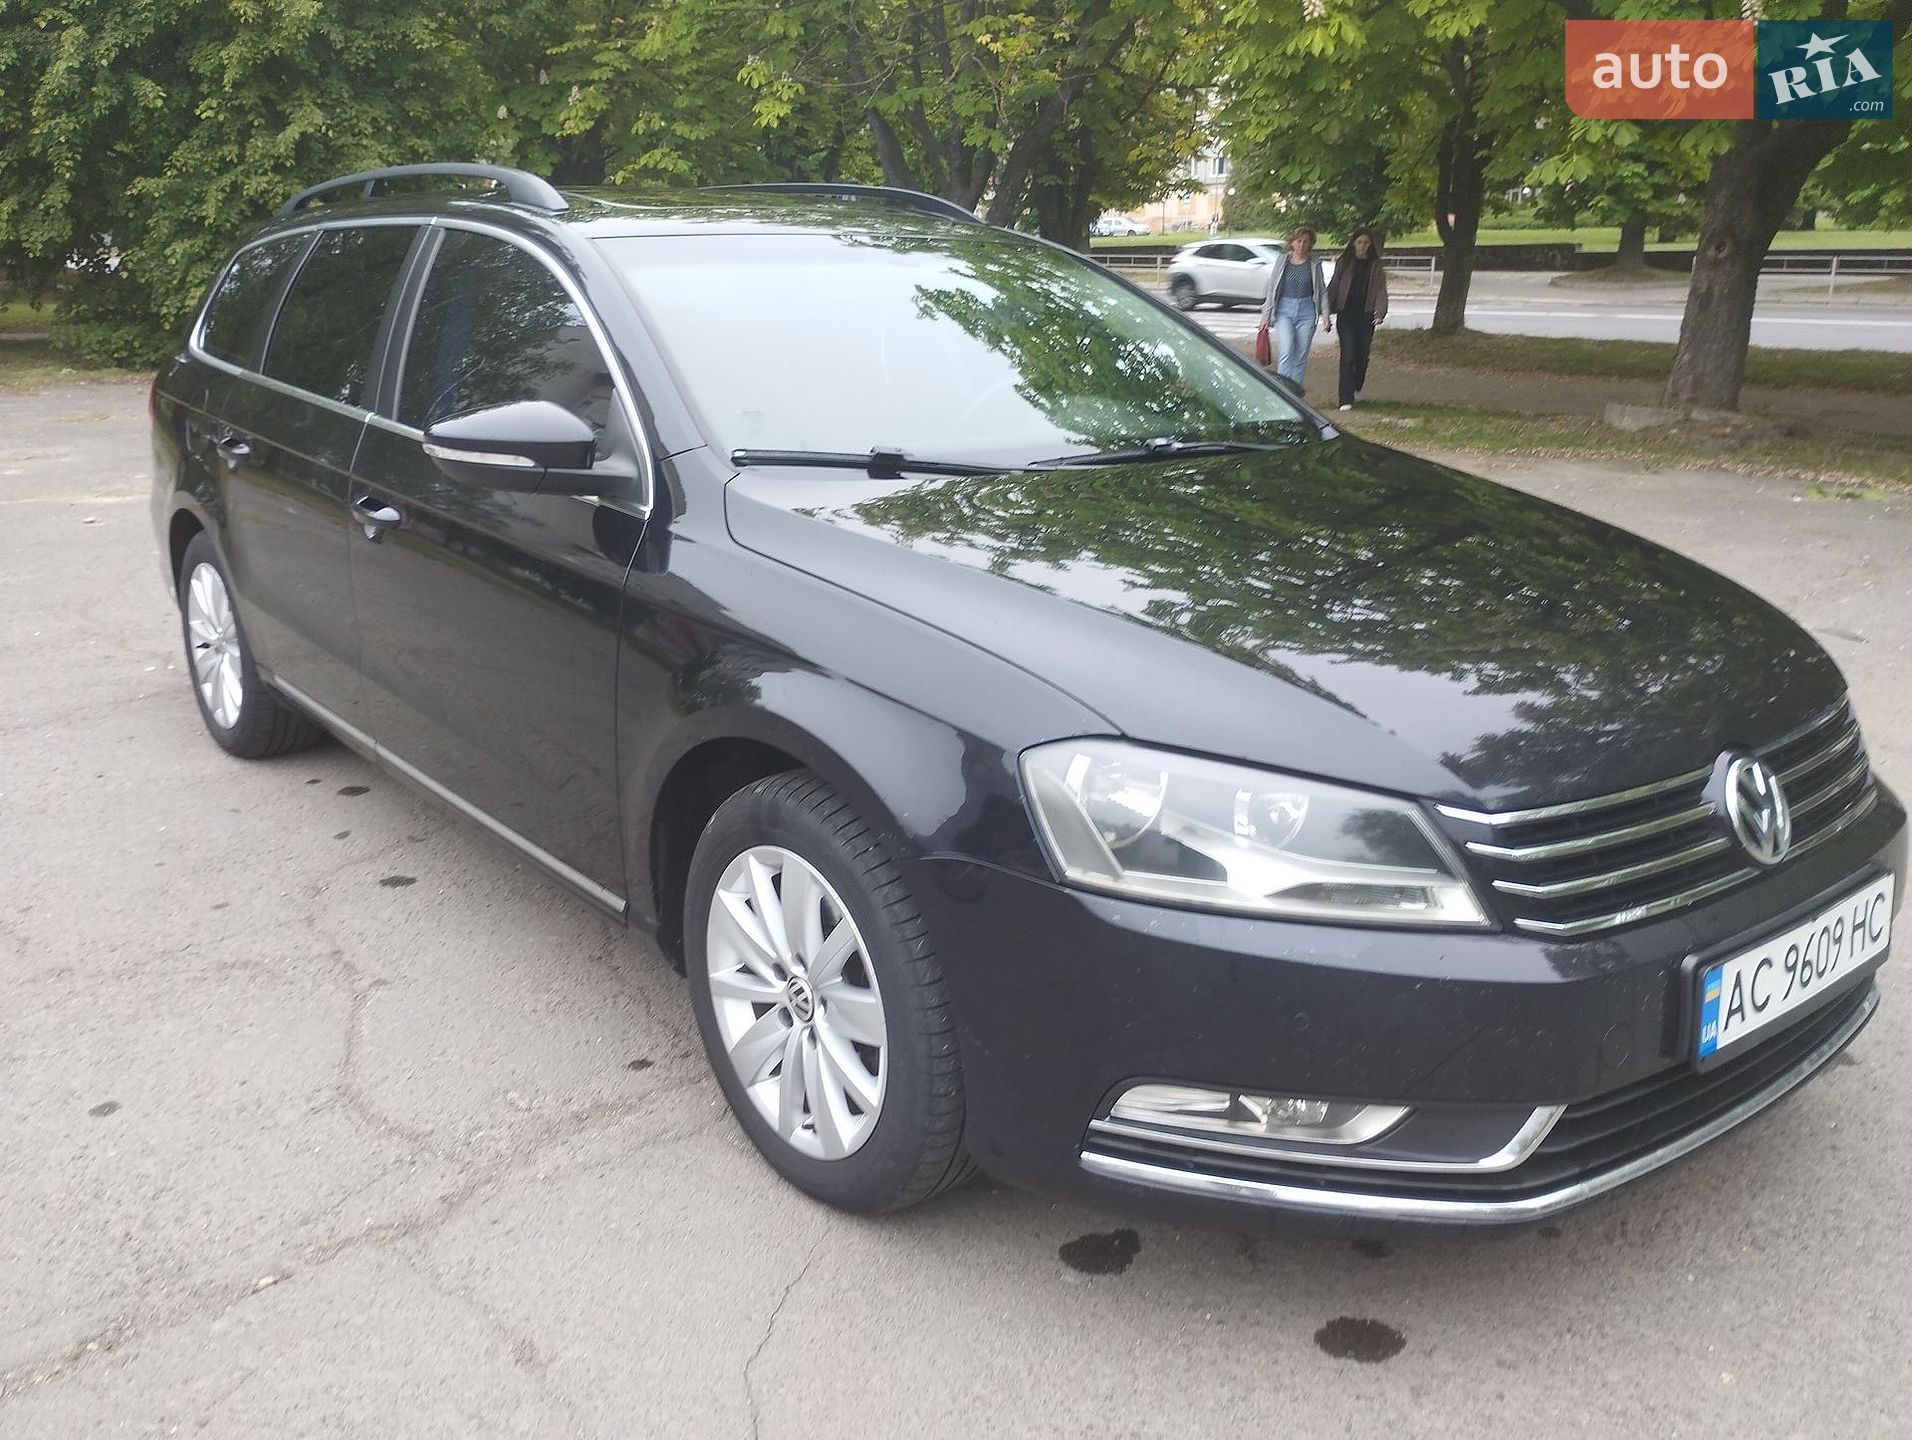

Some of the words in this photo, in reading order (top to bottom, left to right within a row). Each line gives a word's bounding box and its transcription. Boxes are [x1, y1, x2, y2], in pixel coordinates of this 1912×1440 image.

[1723, 957, 1773, 1032] AC
[1783, 916, 1845, 1002] 9609
[1850, 891, 1885, 959] HC
